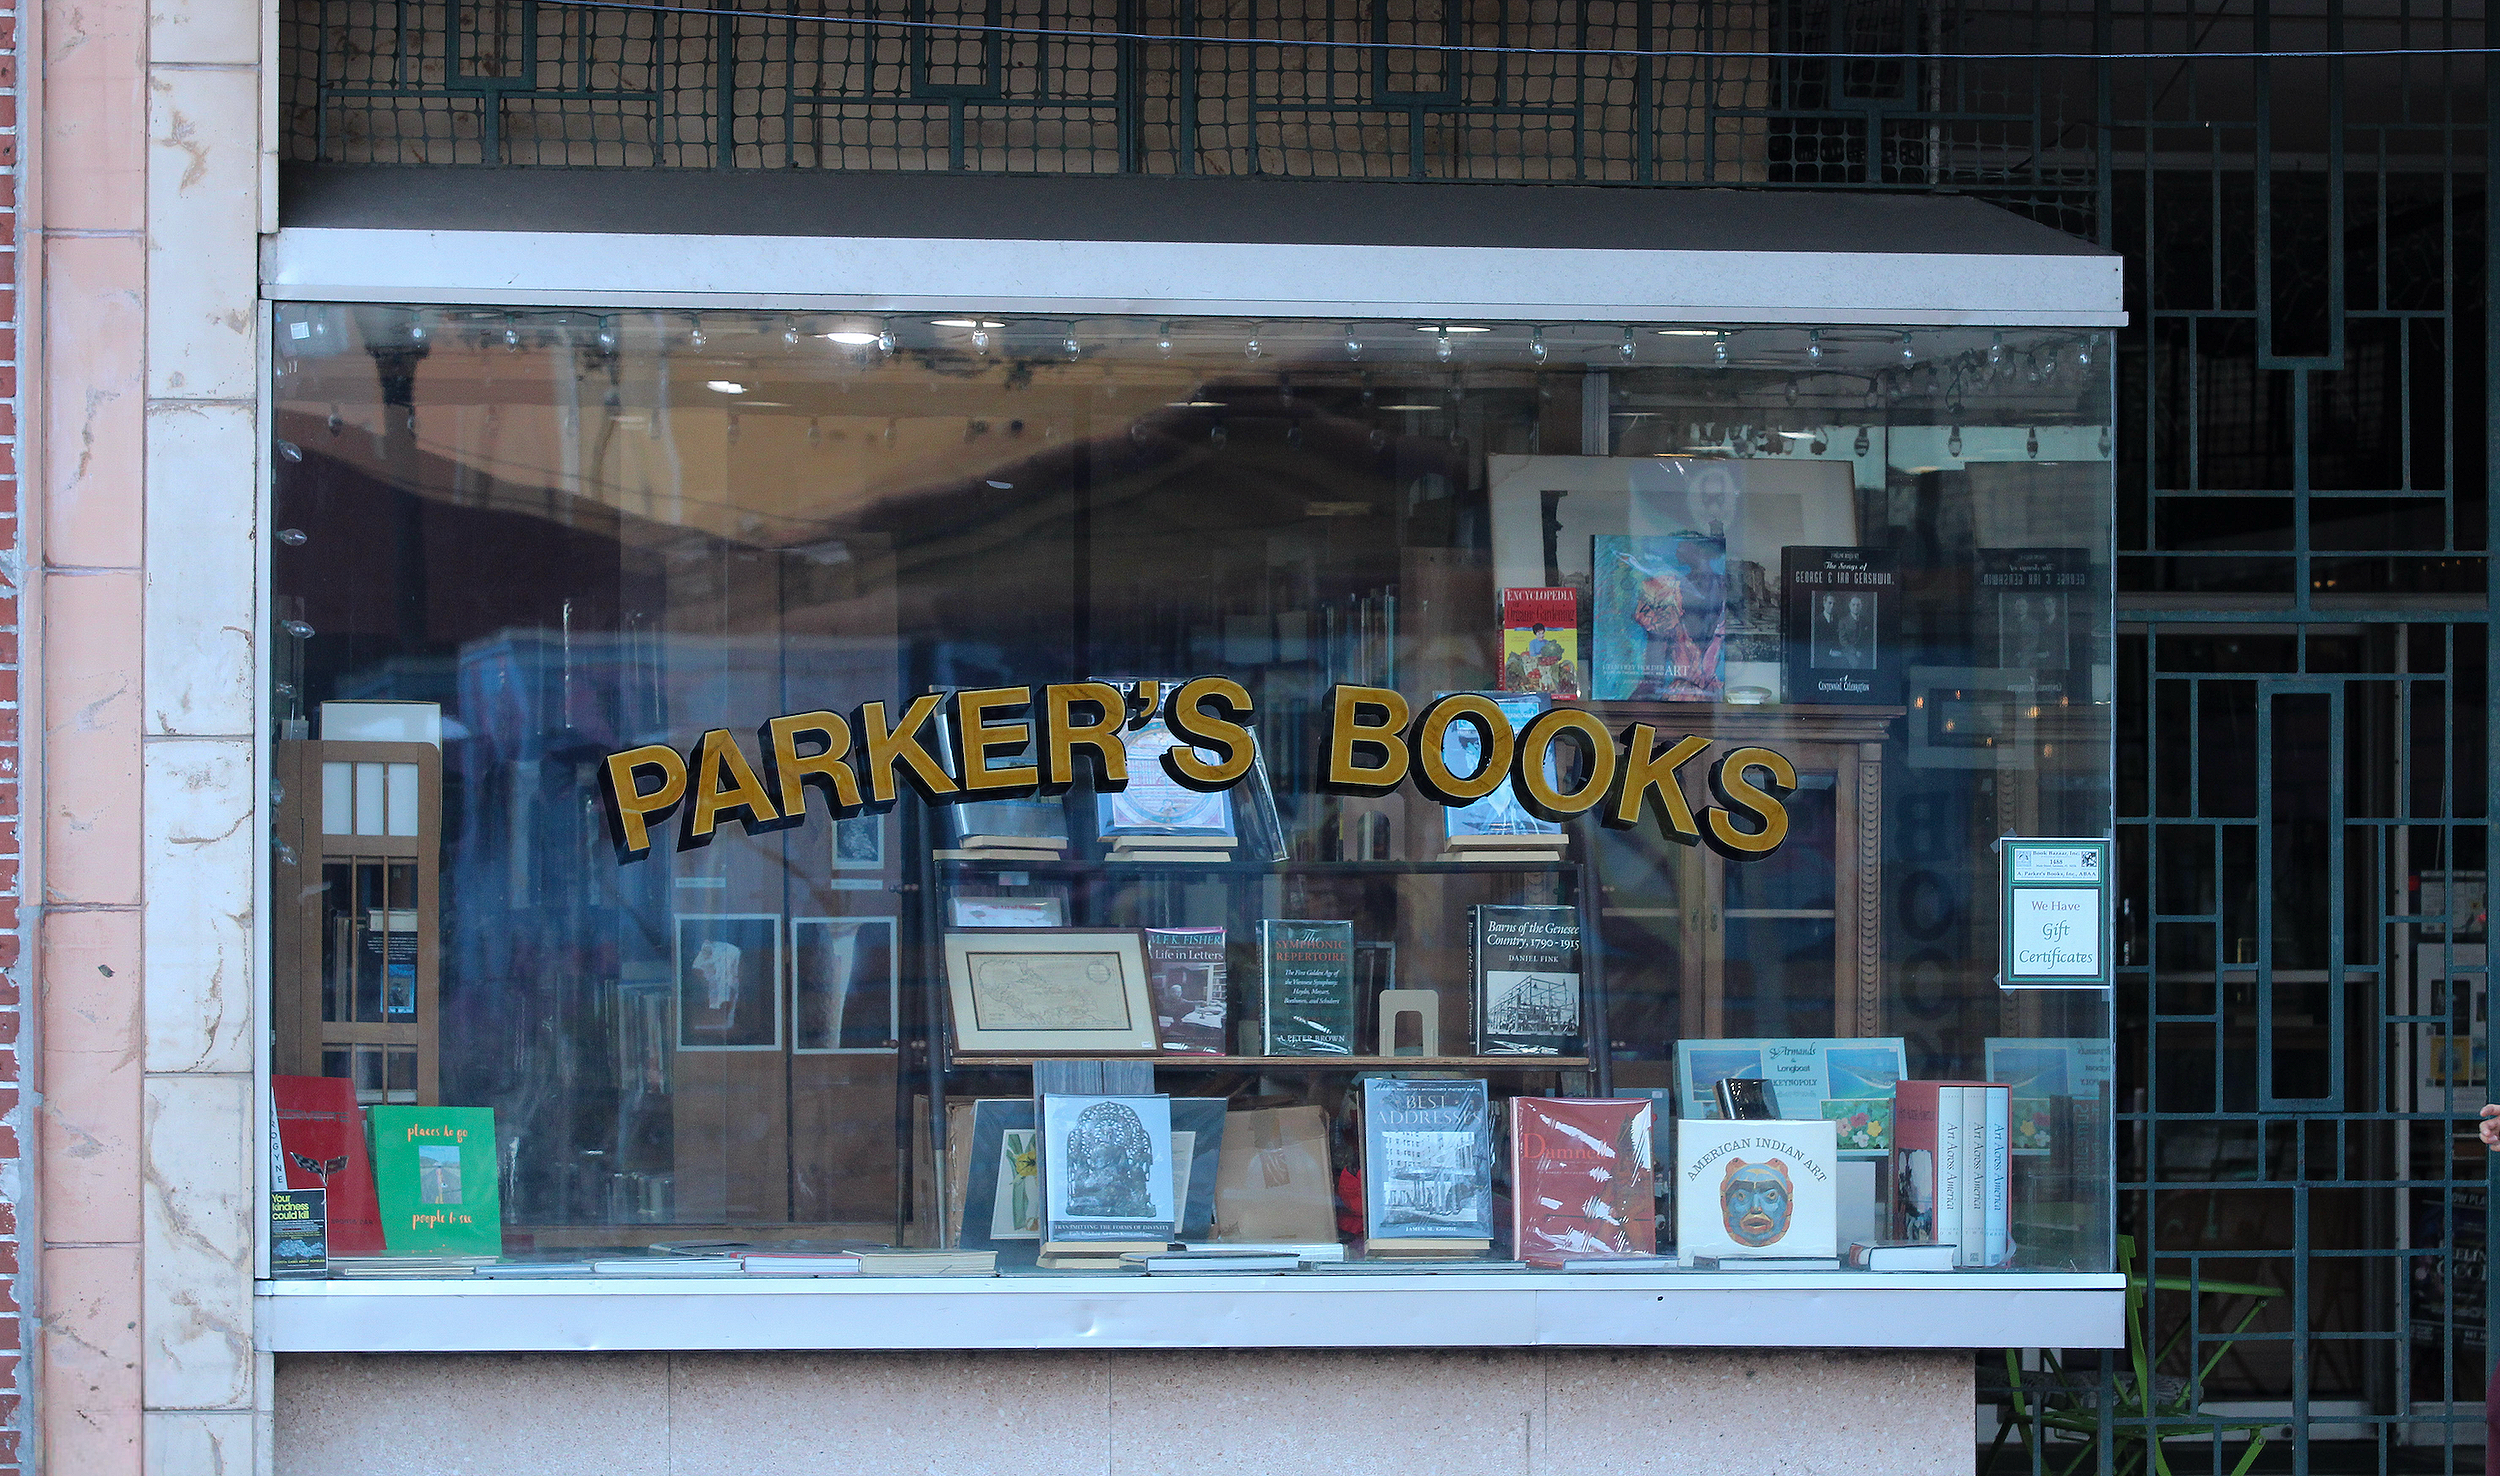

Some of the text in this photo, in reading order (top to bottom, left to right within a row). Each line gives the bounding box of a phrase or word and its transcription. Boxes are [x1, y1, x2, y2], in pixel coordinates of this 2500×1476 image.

[1795, 571, 1823, 583] GEORGE
[1507, 590, 1574, 600] ENCYCLOPEDIA
[603, 676, 1798, 860] PARKER'S BOOKS
[2032, 901, 2080, 911] We Have
[1488, 921, 1580, 935] Barns of the Genesee
[2042, 920, 2070, 942] Gift
[1183, 935, 1221, 945] FISHER
[1276, 941, 1346, 949] SYMPHONIC
[1487, 934, 1529, 949] Country,
[1155, 950, 1224, 960] Life in Letters
[1276, 952, 1347, 961] REPERTOIRE
[2019, 947, 2093, 969] Certificates
[1777, 1064, 1811, 1073] Longboat
[1406, 1095, 1445, 1109] BEST
[407, 1124, 468, 1143] places to go
[1687, 1138, 1827, 1182] AMERICAN INDIAN ART
[1947, 1122, 1957, 1210] Art Across America
[1974, 1122, 1984, 1210] Art Across America
[1994, 1123, 2004, 1211] Art Across America
[272, 1194, 291, 1203] Your
[272, 1203, 309, 1212] kindness
[272, 1211, 309, 1220] could kill
[412, 1209, 445, 1230] people
[458, 1214, 472, 1224] see
